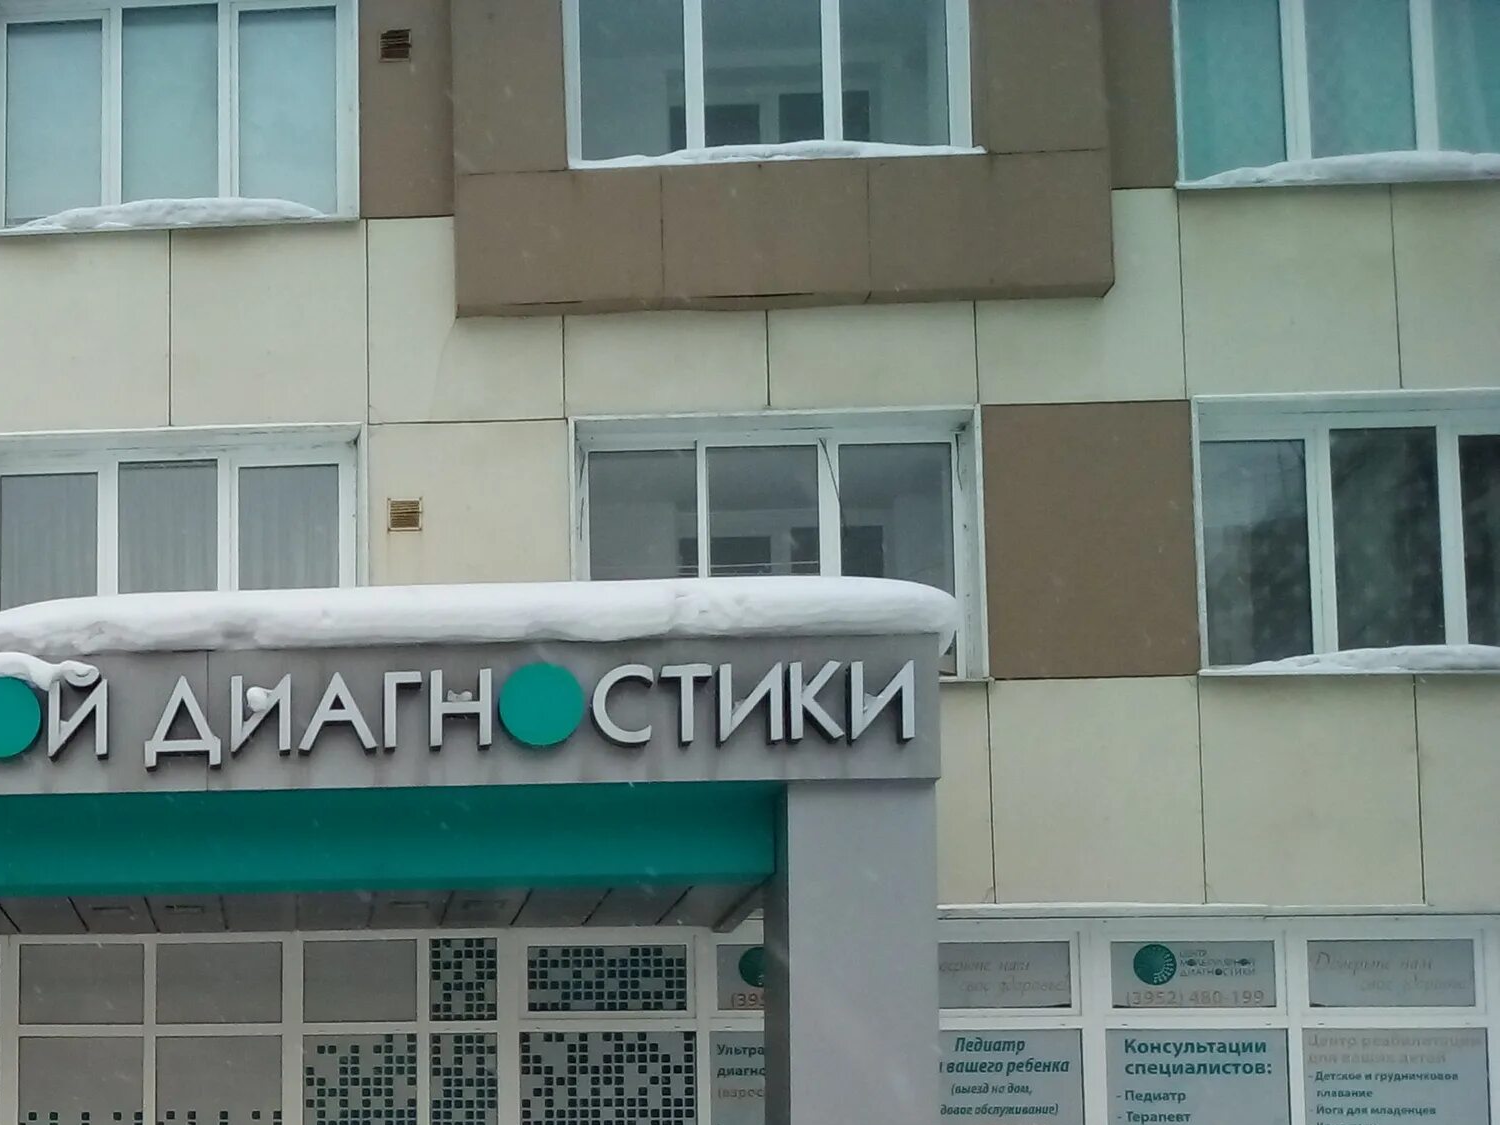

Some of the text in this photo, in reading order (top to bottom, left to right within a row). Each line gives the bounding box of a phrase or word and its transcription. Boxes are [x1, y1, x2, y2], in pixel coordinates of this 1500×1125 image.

[144, 660, 916, 771] ДИАГНОСТИКИ
[731, 992, 764, 1008] (39
[716, 1043, 765, 1058] Ультра
[954, 1036, 1026, 1055] Педиатр
[1123, 1038, 1268, 1058] Консультации
[716, 1067, 766, 1079] диагно
[946, 1060, 1003, 1074] вашего
[1005, 1057, 1070, 1077] ребенка
[1124, 1062, 1273, 1078] специалистов:
[1124, 1089, 1187, 1103] Педиатр
[974, 1103, 1059, 1118] обслуживание)
[1315, 1103, 1344, 1116] Йога
[1126, 1111, 1192, 1124] Терапевт
